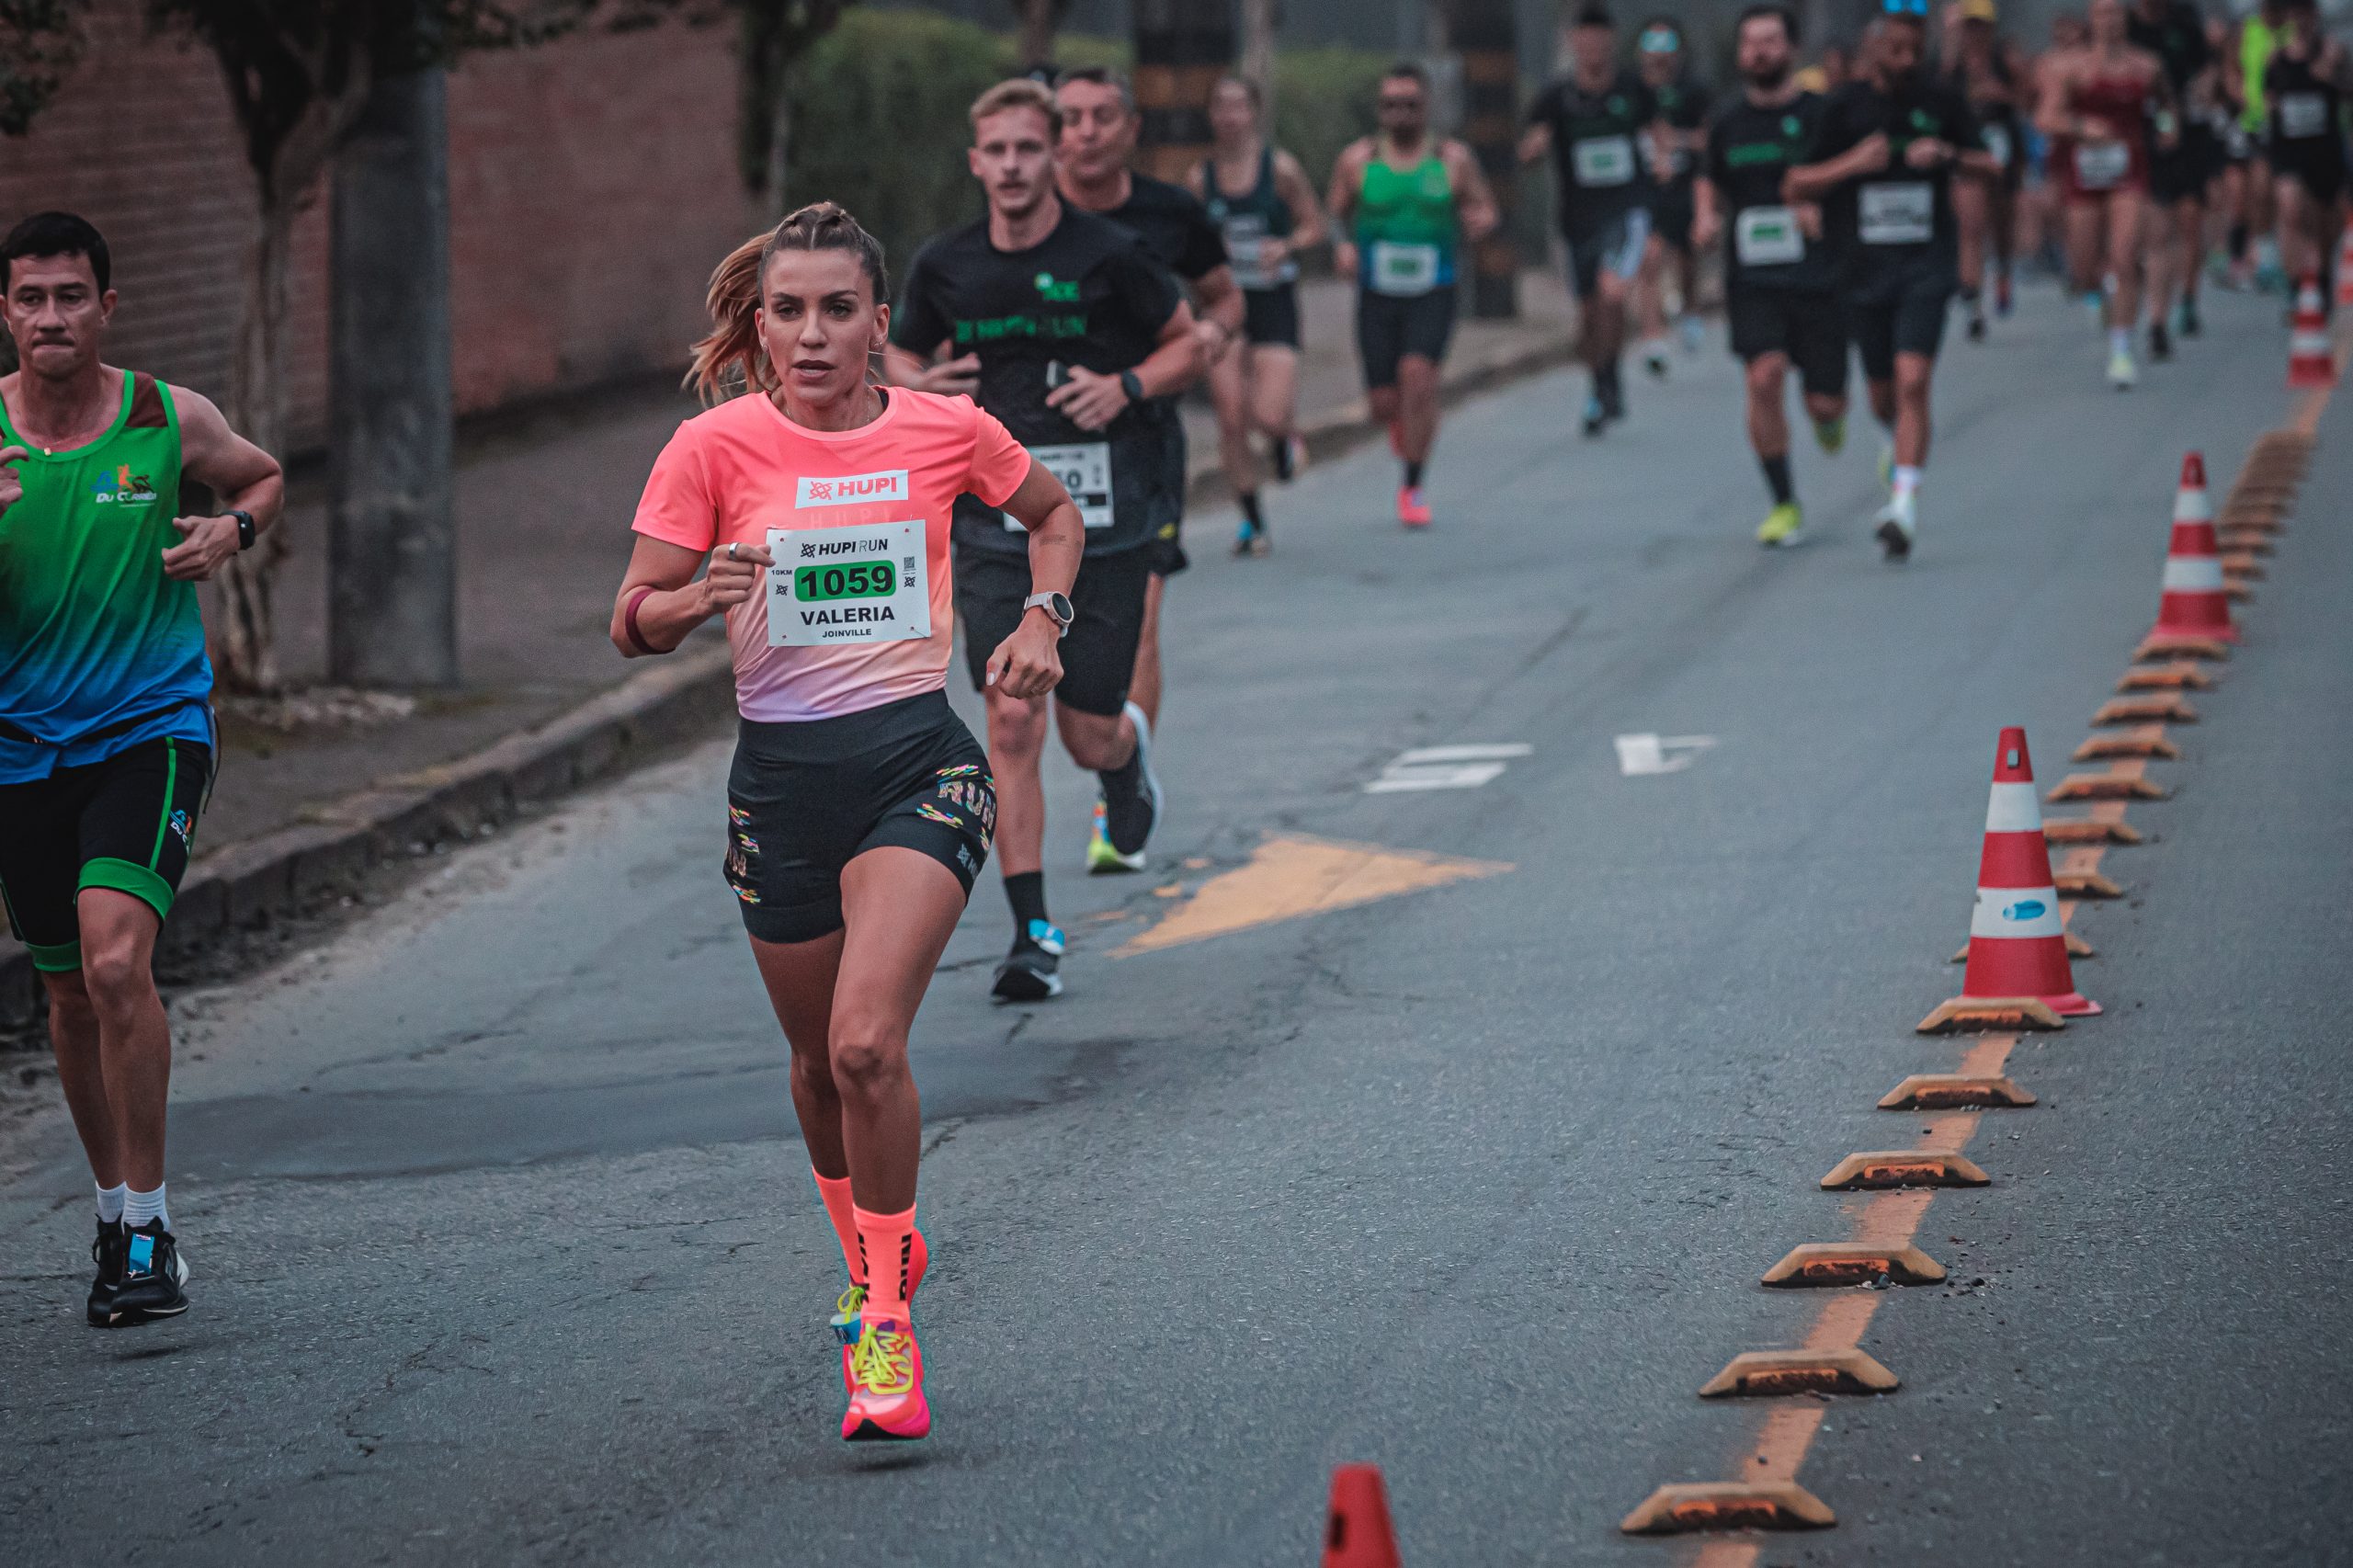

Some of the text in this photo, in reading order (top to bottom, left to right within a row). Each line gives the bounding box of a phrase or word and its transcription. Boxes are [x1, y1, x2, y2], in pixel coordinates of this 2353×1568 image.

[837, 476, 897, 497] HUPI
[818, 539, 889, 556] HUPI RUN
[801, 565, 893, 597] 1059
[801, 606, 895, 626] VALERIA
[823, 629, 872, 639] JOINVILLE
